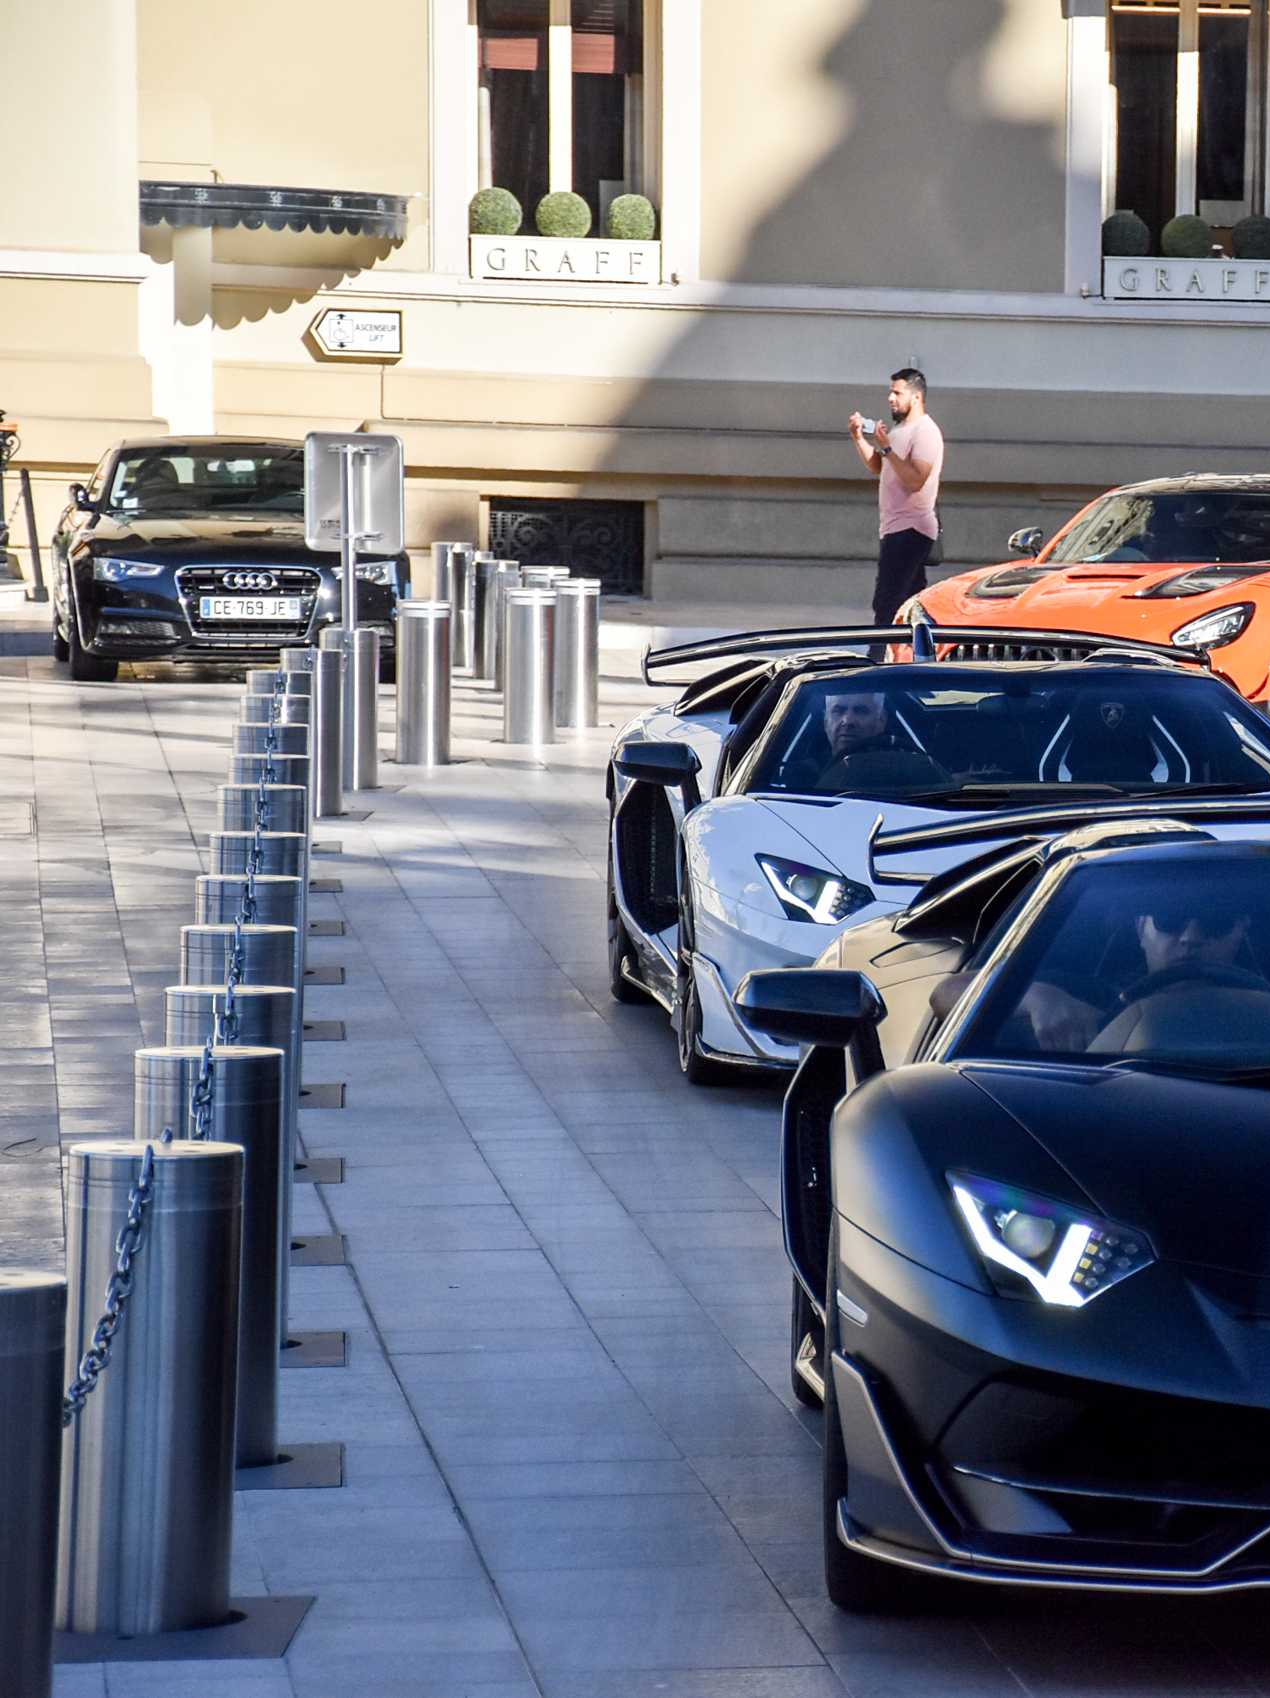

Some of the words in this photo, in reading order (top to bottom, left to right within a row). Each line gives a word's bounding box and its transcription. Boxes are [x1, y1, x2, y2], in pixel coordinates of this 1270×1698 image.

[486, 248, 644, 275] GRAFF
[1119, 268, 1269, 293] GRAFF
[354, 323, 397, 332] ASCENSEUR
[368, 334, 385, 342] LIFT
